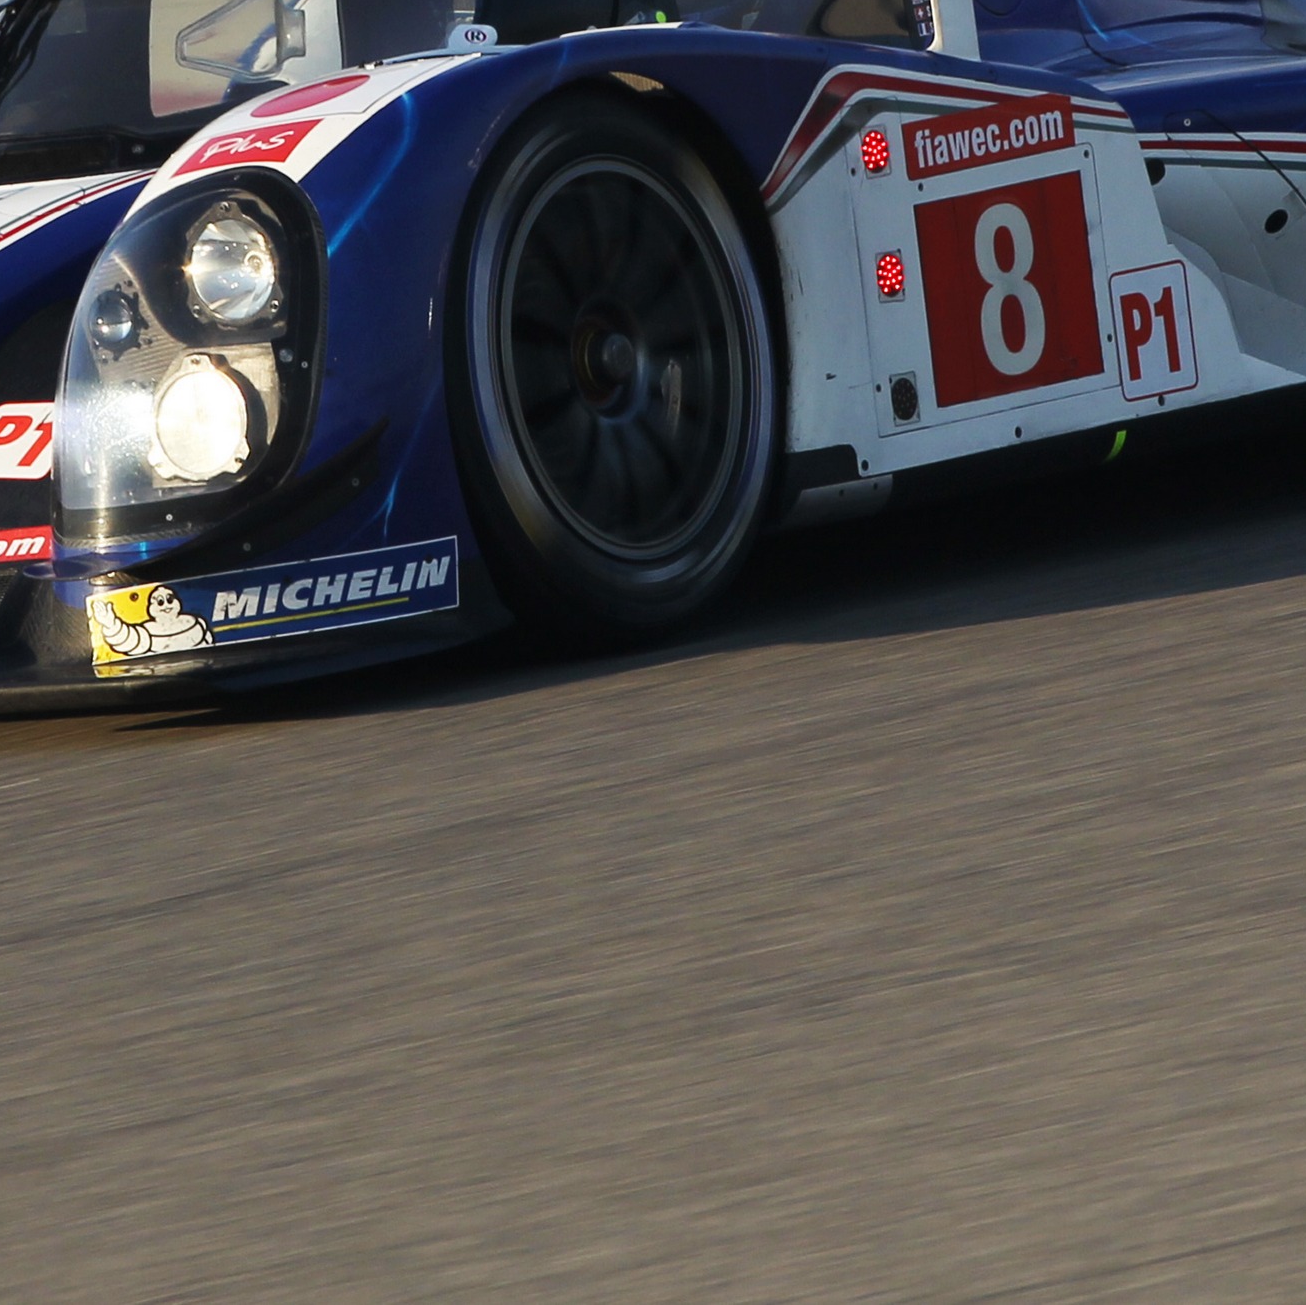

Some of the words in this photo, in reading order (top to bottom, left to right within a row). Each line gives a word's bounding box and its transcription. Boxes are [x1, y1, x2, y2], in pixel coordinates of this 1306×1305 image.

[914, 107, 1065, 168] fiawec.com
[974, 202, 1046, 376] 8
[1119, 285, 1182, 382] P1
[212, 555, 451, 622] MICHELIN
